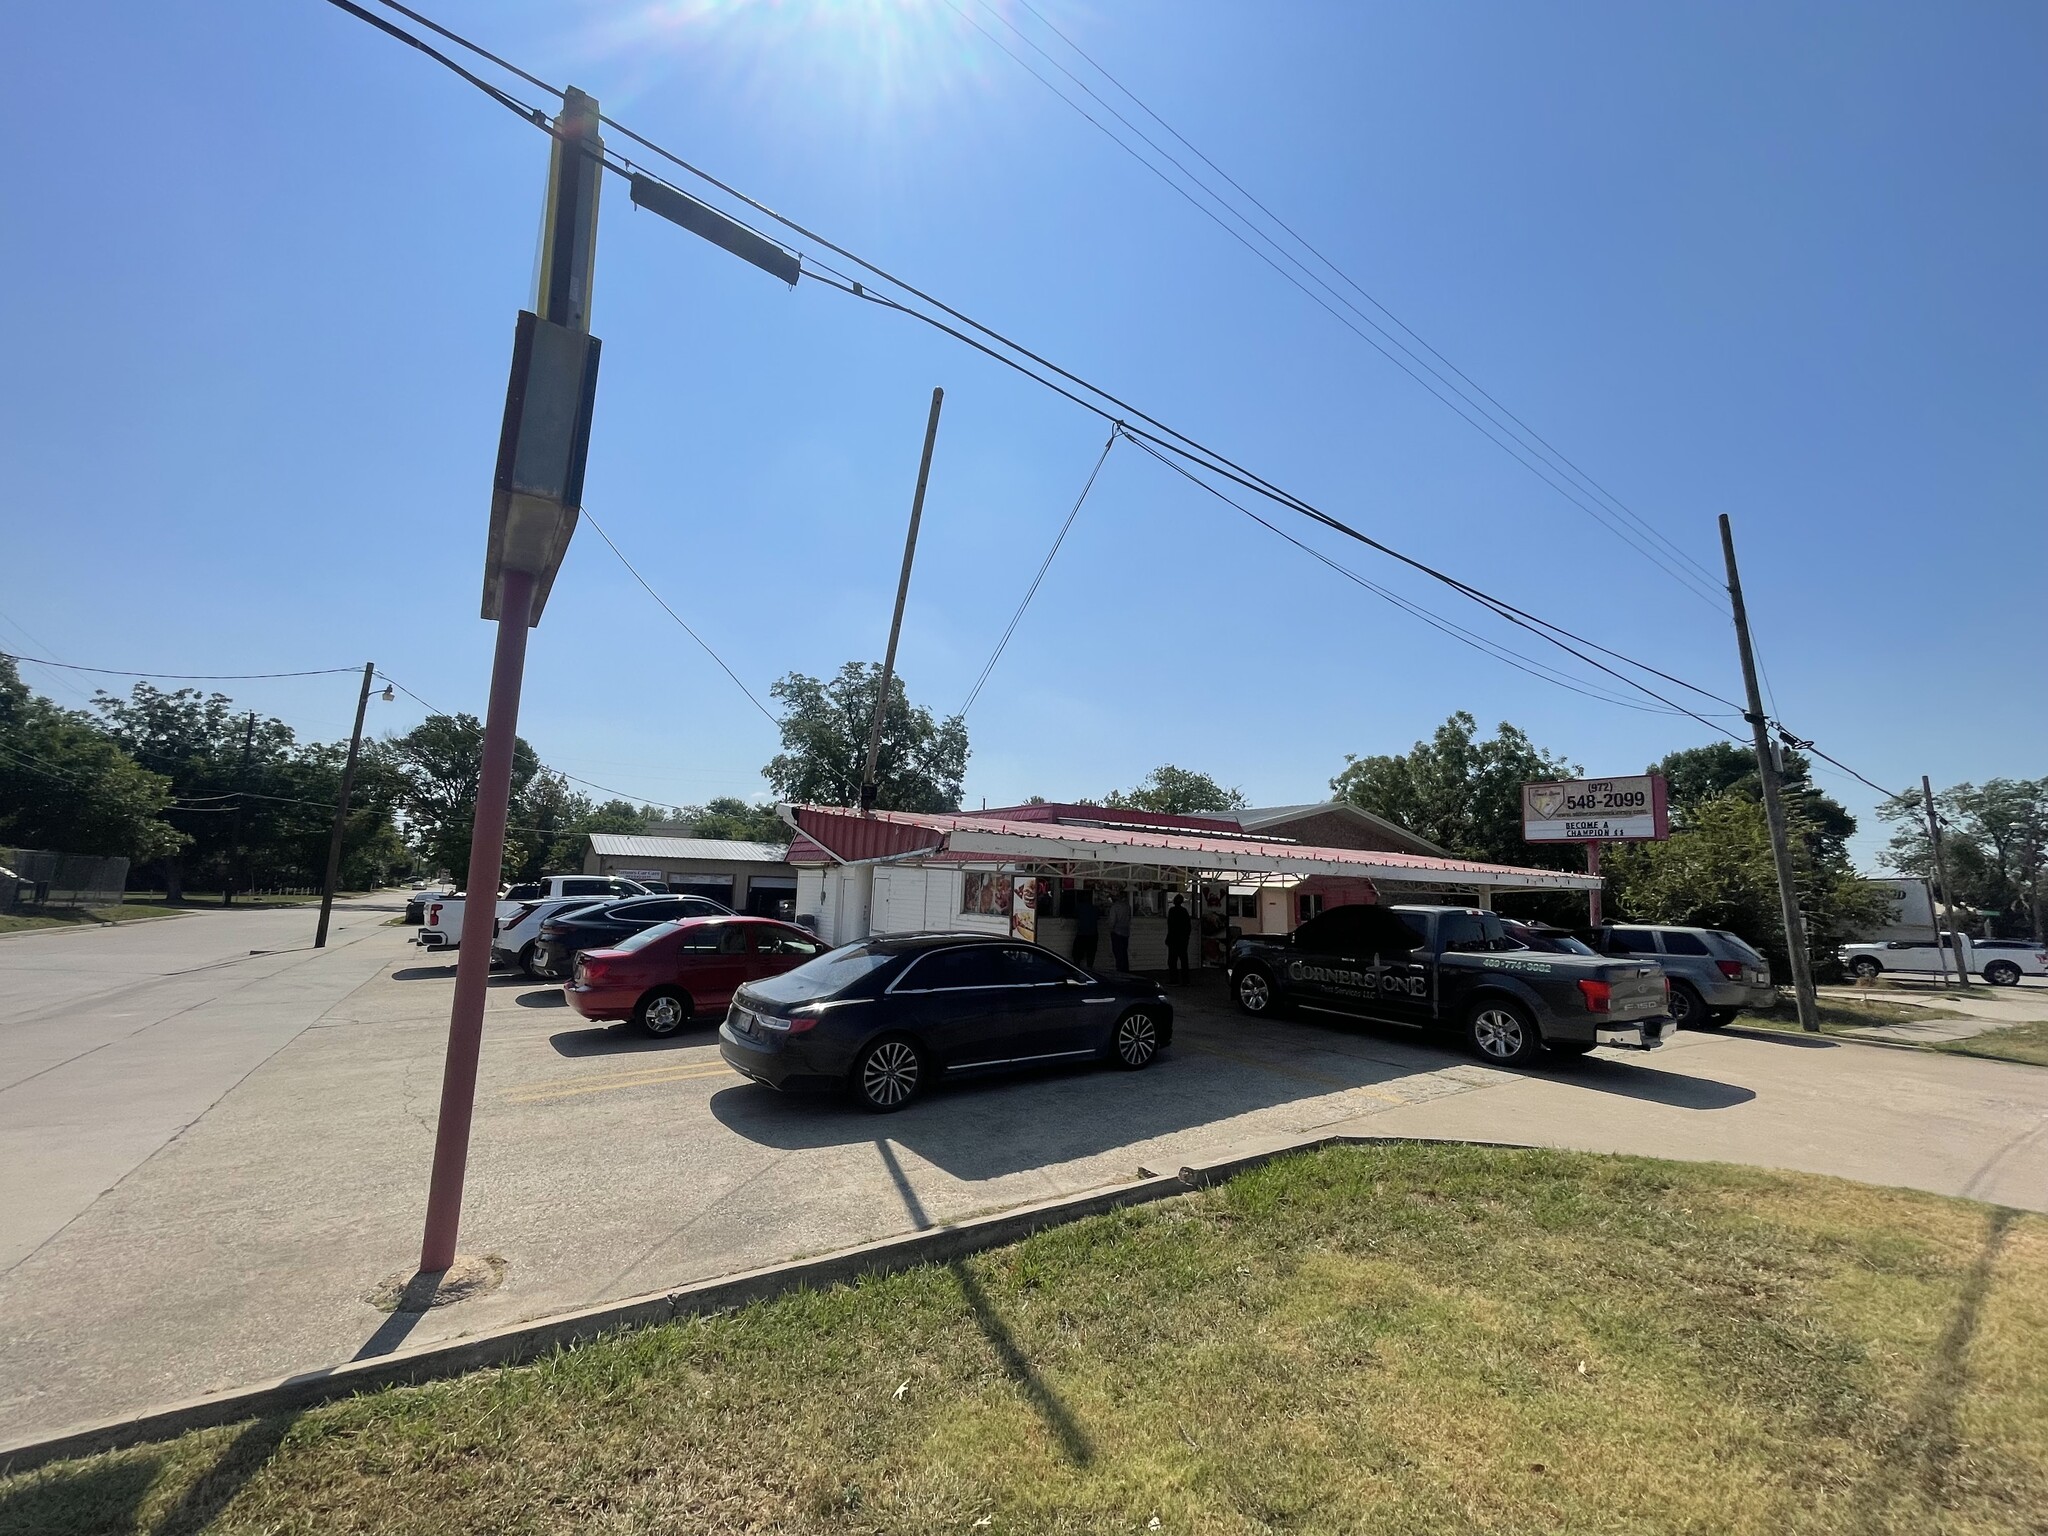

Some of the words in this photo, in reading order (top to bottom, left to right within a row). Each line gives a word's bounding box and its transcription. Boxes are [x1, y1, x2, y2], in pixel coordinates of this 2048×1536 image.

[1588, 782, 1613, 793] (972)
[1567, 791, 1645, 809] 548-2099
[1566, 821, 1598, 829] BECOME
[1566, 829, 1610, 837] CHAMPION
[1624, 1001, 1657, 1011] F-150
